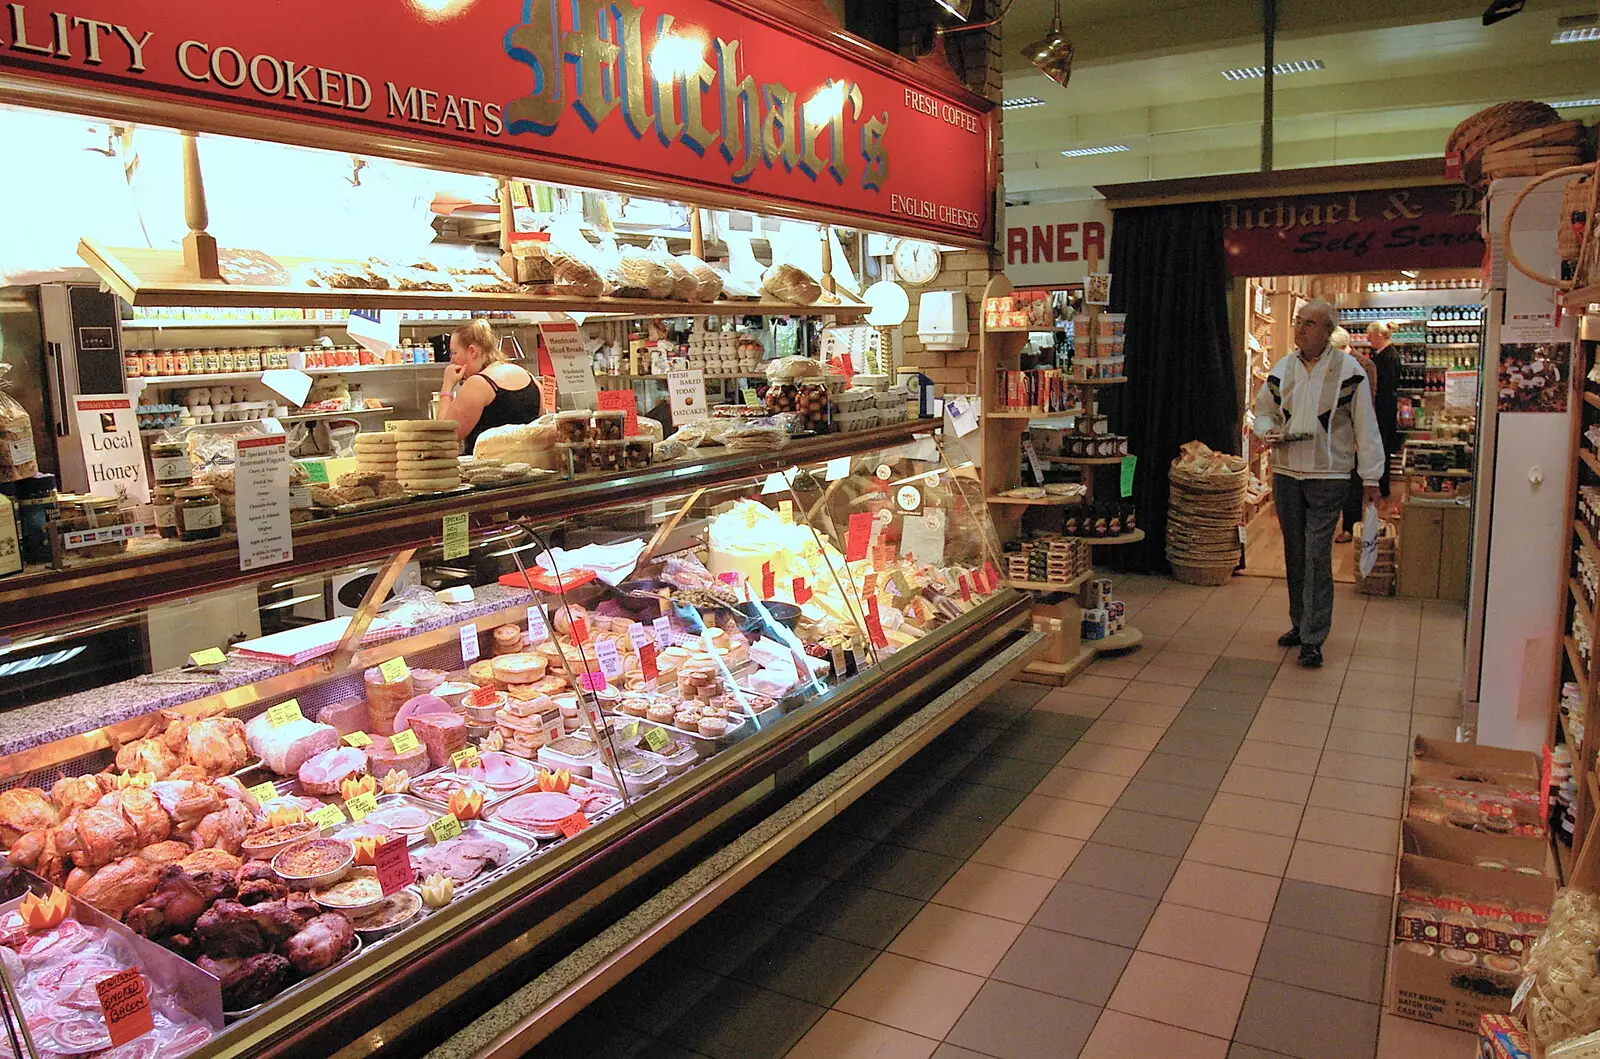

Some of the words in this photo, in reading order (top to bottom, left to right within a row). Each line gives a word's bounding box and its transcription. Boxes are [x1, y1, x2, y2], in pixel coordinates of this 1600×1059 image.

[0, 2, 154, 73] LITY
[175, 39, 373, 112] COOKED
[385, 80, 504, 137] MEATS
[503, 0, 890, 192] Michael's
[904, 87, 938, 119] FRESH
[942, 104, 978, 135] COFFEE
[891, 193, 937, 221] ENGLISH
[939, 205, 979, 230] CHEESES
[1383, 190, 1426, 221] &
[1007, 221, 1105, 265] RNER
[1291, 229, 1376, 257] Self
[549, 337, 578, 345] Handmade
[675, 387, 696, 395] TODAY
[680, 378, 702, 386] BAKED
[673, 407, 707, 417] OATCAKES
[90, 429, 134, 452] Local
[91, 462, 140, 483] Honey
[240, 459, 266, 467] Homemade
[1398, 997, 1423, 1009] BATCH
[1424, 1003, 1444, 1014] CODE
[1399, 989, 1417, 1001] BEST
[110, 996, 144, 1024] BACON
[1397, 1006, 1417, 1017] CASE
